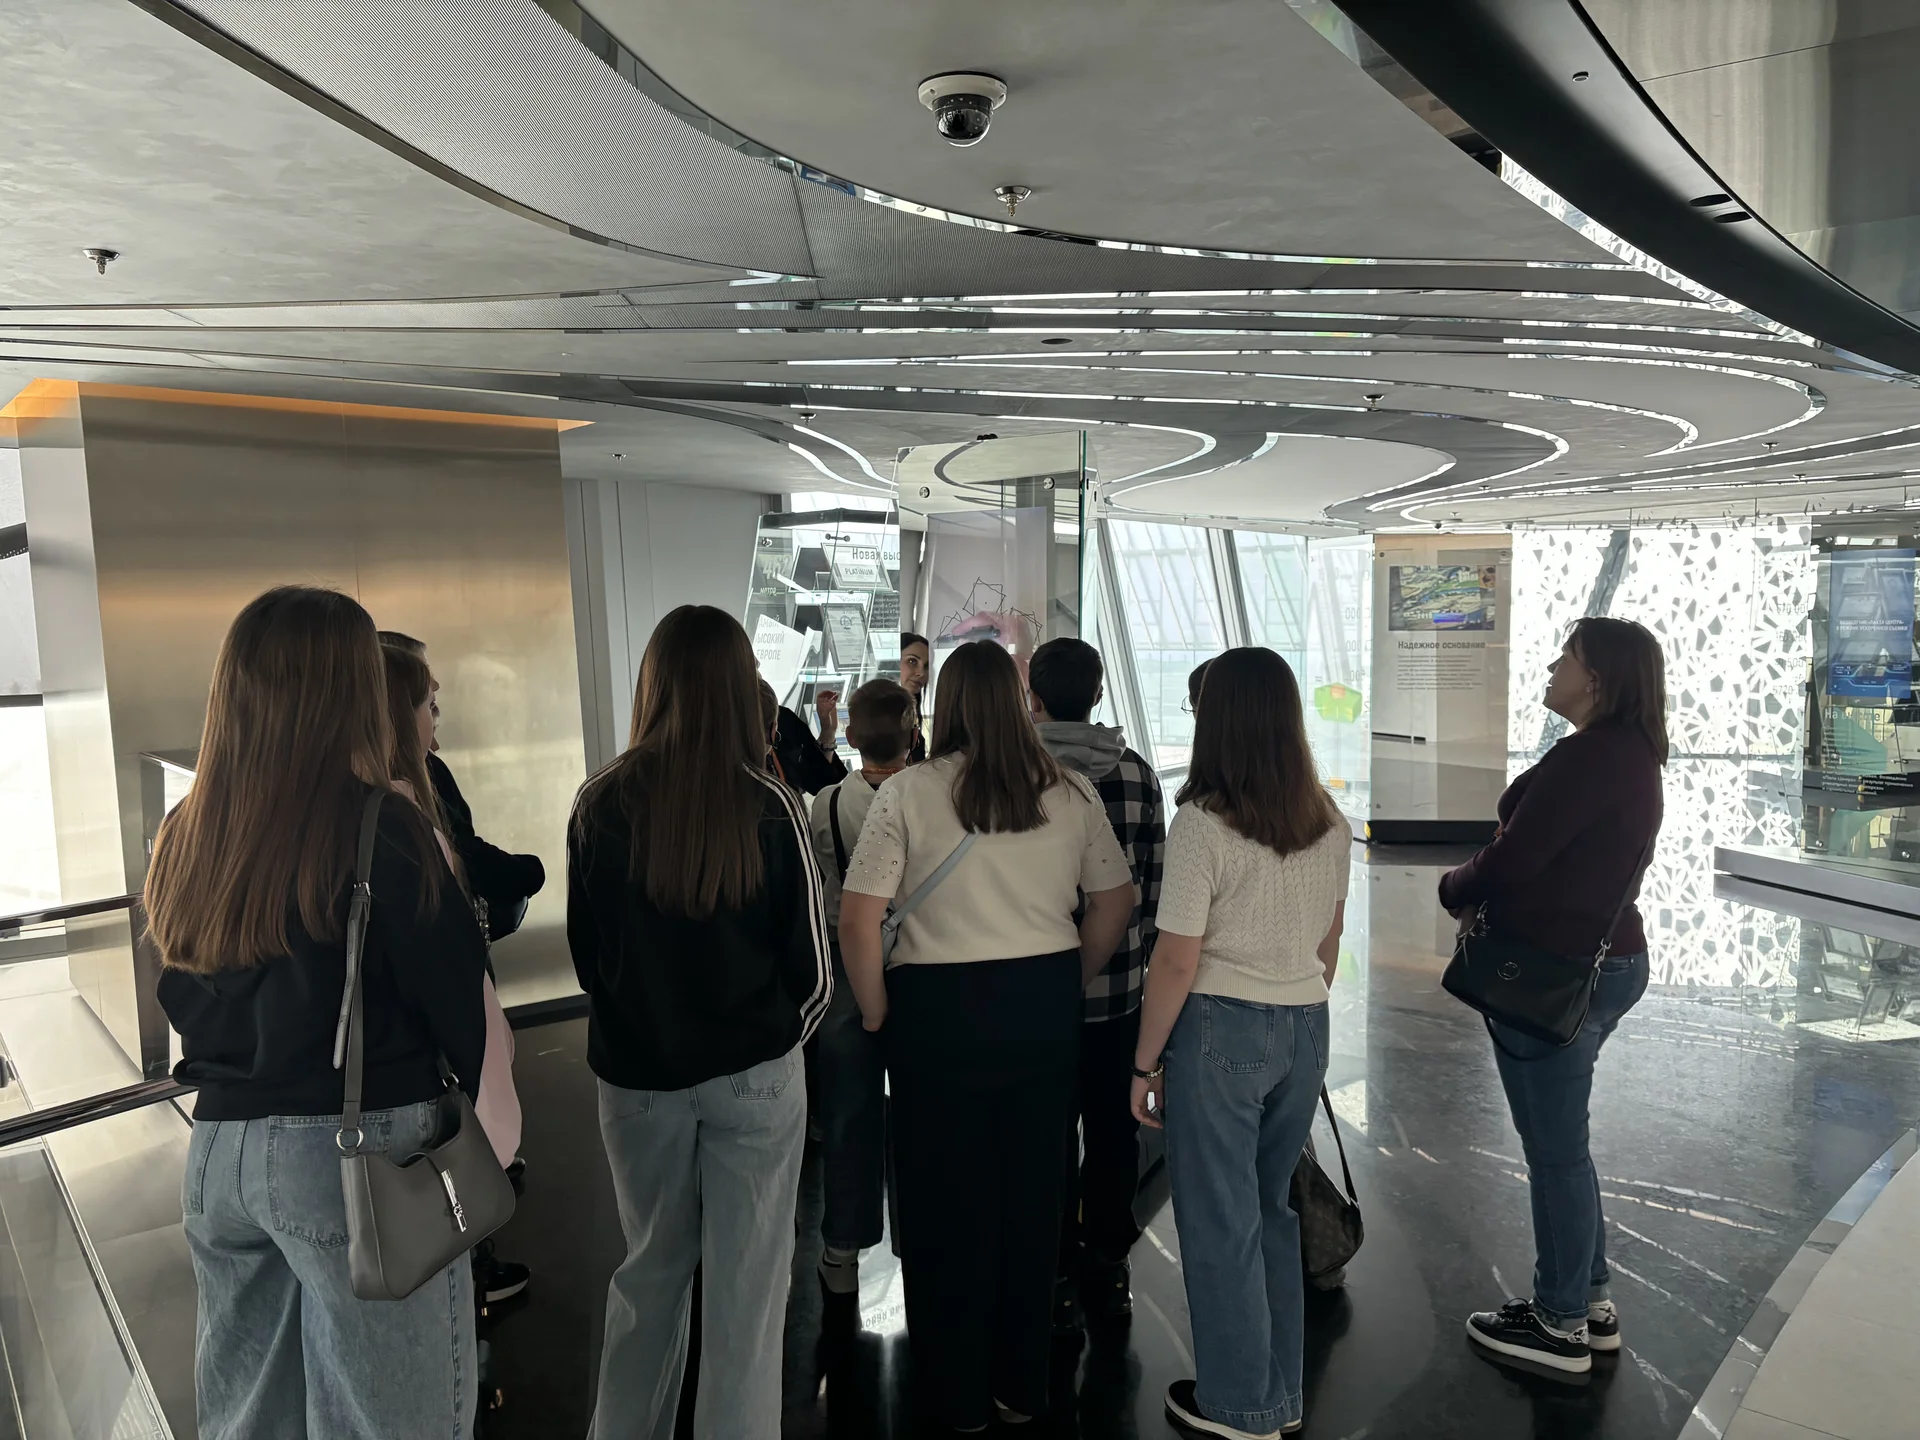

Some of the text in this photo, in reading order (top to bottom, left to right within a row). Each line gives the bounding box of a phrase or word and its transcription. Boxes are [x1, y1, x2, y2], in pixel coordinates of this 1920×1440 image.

[852, 547, 881, 560] Новая
[1397, 641, 1486, 650] Надежное основание
[1825, 708, 1838, 719] На
